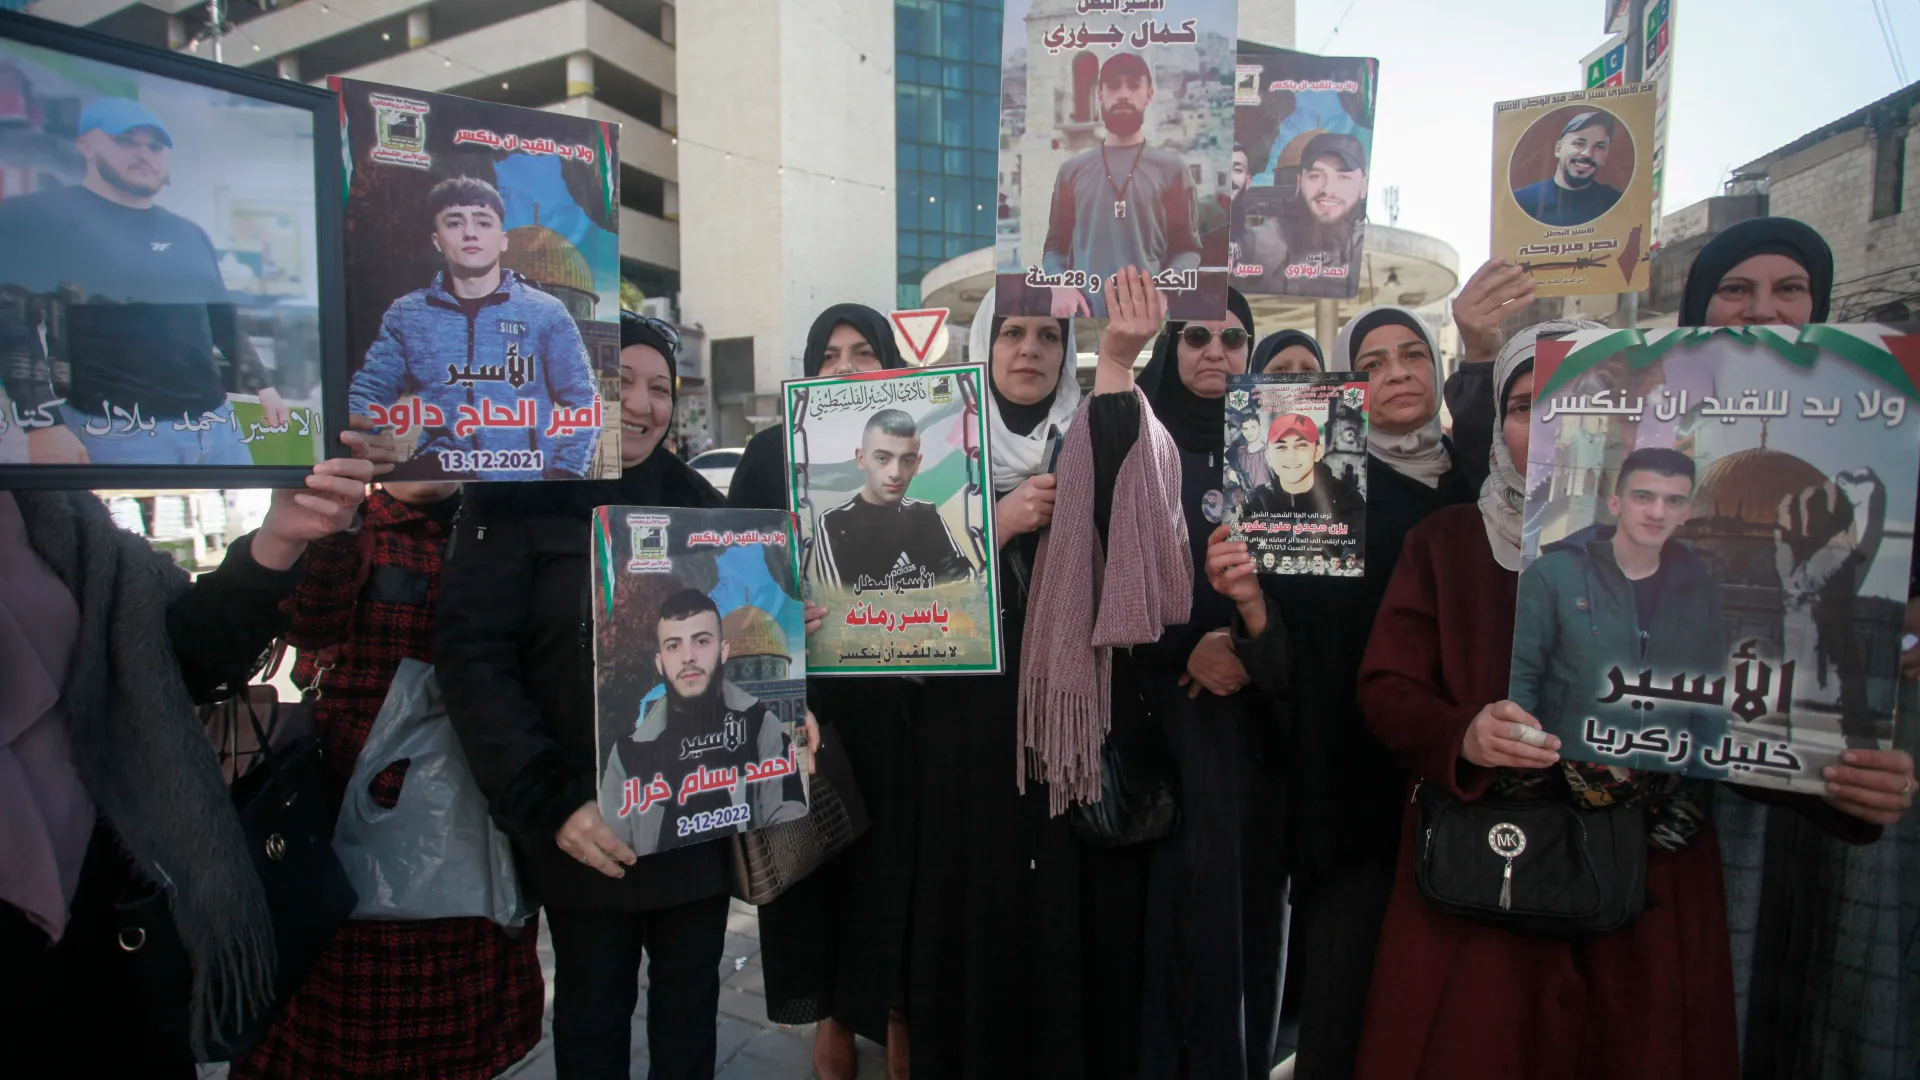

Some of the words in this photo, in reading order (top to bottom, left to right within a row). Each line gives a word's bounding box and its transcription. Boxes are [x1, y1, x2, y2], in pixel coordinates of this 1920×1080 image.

[1043, 22, 1125, 53] جوري
[1130, 19, 1197, 48] كمال
[1610, 54, 1617, 69] C
[454, 130, 500, 149] ينكسر
[503, 135, 518, 150] ان
[521, 138, 555, 155] للقيد
[558, 145, 573, 160] بد
[576, 144, 593, 163] ولا
[1518, 240, 1584, 257] مبروكة
[1587, 236, 1618, 253] نصر
[1026, 264, 1061, 288] سنة
[1063, 271, 1086, 287] 28
[1234, 263, 1263, 278] معين
[1089, 275, 1101, 293] و
[444, 342, 535, 389] الأسير
[1542, 389, 1644, 423] ينكسر
[1655, 389, 1687, 421] ان
[1701, 389, 1789, 424] للقيد
[1803, 394, 1841, 426] بد
[1857, 389, 1906, 427] ولا
[84, 400, 157, 438] بلال
[172, 409, 237, 433] احمد
[367, 397, 445, 436] داود
[455, 399, 536, 438] الحاج
[545, 394, 602, 437] أمير
[239, 408, 321, 444] الاسير
[440, 451, 543, 470] 13.12.2021
[1270, 511, 1292, 519] الشهيد
[1268, 521, 1292, 533] منير
[1292, 522, 1327, 535] مجدي
[1328, 522, 1349, 535] يزن
[687, 531, 720, 546] ينكسر
[722, 531, 733, 546] ان
[735, 532, 759, 546] للقيد
[761, 532, 771, 545] بد
[773, 531, 786, 546] ولا
[853, 573, 894, 597] البطل
[898, 600, 950, 632] ياسر
[838, 646, 882, 664] ينكسر
[884, 640, 895, 662] أن
[896, 645, 932, 663] للقيد
[934, 648, 947, 660] بد
[949, 645, 958, 658] لا
[1596, 637, 1796, 723] الأسير
[679, 711, 747, 760] الأسير
[1583, 718, 1690, 763] زكريا
[745, 743, 797, 782] أحمد
[1702, 735, 1803, 772] خليل
[619, 773, 672, 817] خراز
[679, 765, 738, 805] بسام
[678, 805, 750, 835] 2-12-2022
[1496, 832, 1518, 847] MK
